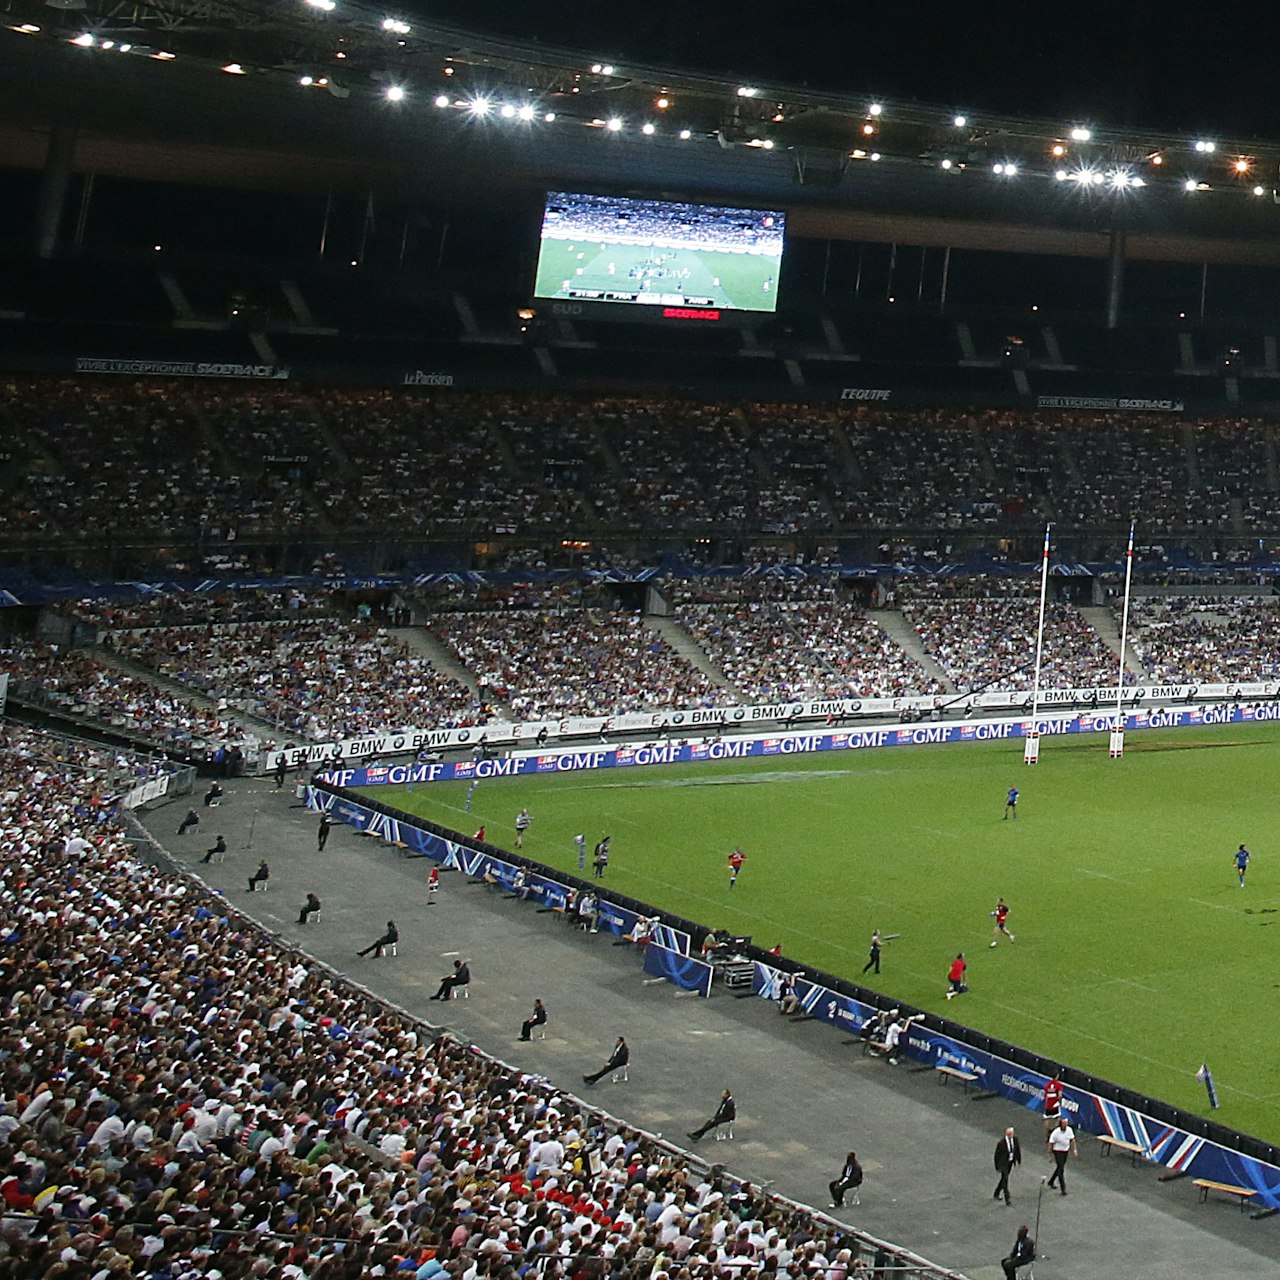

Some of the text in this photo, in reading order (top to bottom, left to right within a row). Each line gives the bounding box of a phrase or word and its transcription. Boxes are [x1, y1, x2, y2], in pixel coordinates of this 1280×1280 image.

[77, 361, 108, 370] VIVRE
[110, 362, 194, 373] L'EXCEPTIONNEL
[415, 370, 453, 386] Parisien
[1044, 690, 1076, 702] BMW
[1152, 687, 1182, 698] BMW
[692, 709, 726, 723] BMW
[752, 707, 786, 719] BMW
[811, 702, 844, 714] BMW
[1093, 716, 1129, 731] GMF
[1149, 713, 1183, 727] GMF
[1203, 711, 1236, 724] GMF
[976, 724, 1013, 740] GMF
[1037, 719, 1072, 735] GMF
[413, 730, 449, 746] BMW
[850, 732, 889, 748] GMF
[913, 728, 952, 744] GMF
[350, 738, 387, 756] BMW
[709, 741, 754, 758] GMF
[780, 736, 823, 753] GMF
[292, 746, 324, 764] BW
[557, 753, 606, 771] GMF
[634, 746, 682, 764] GMF
[388, 763, 443, 784] GMF
[476, 759, 526, 777] GMF
